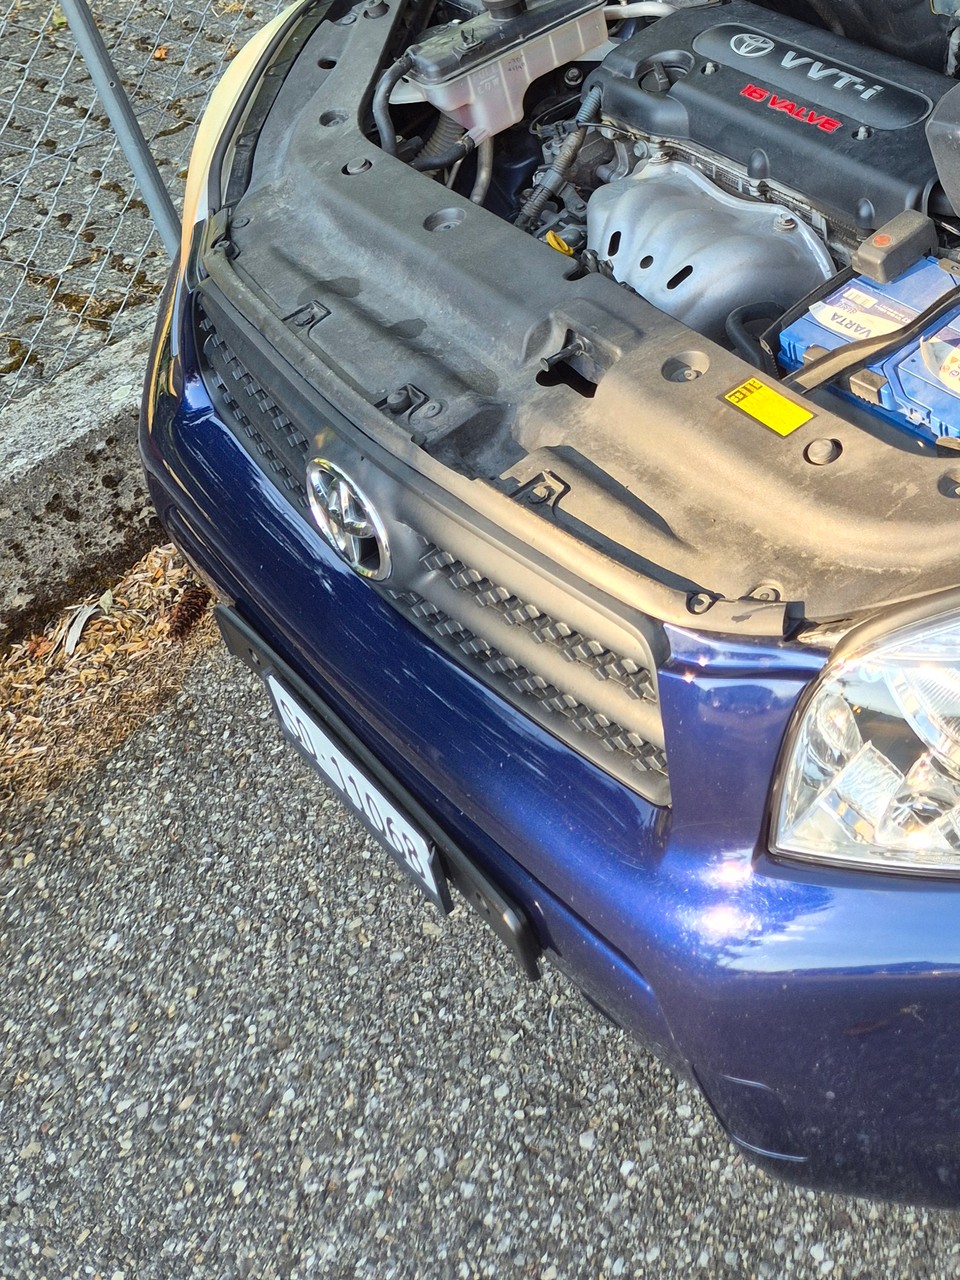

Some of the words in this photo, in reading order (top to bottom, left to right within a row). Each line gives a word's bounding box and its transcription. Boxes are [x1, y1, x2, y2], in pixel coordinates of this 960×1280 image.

[781, 51, 884, 101] VVT-i
[740, 83, 770, 103] 16
[768, 94, 843, 134] VALVE
[830, 312, 872, 338] VARTA
[330, 755, 426, 880] 11068
